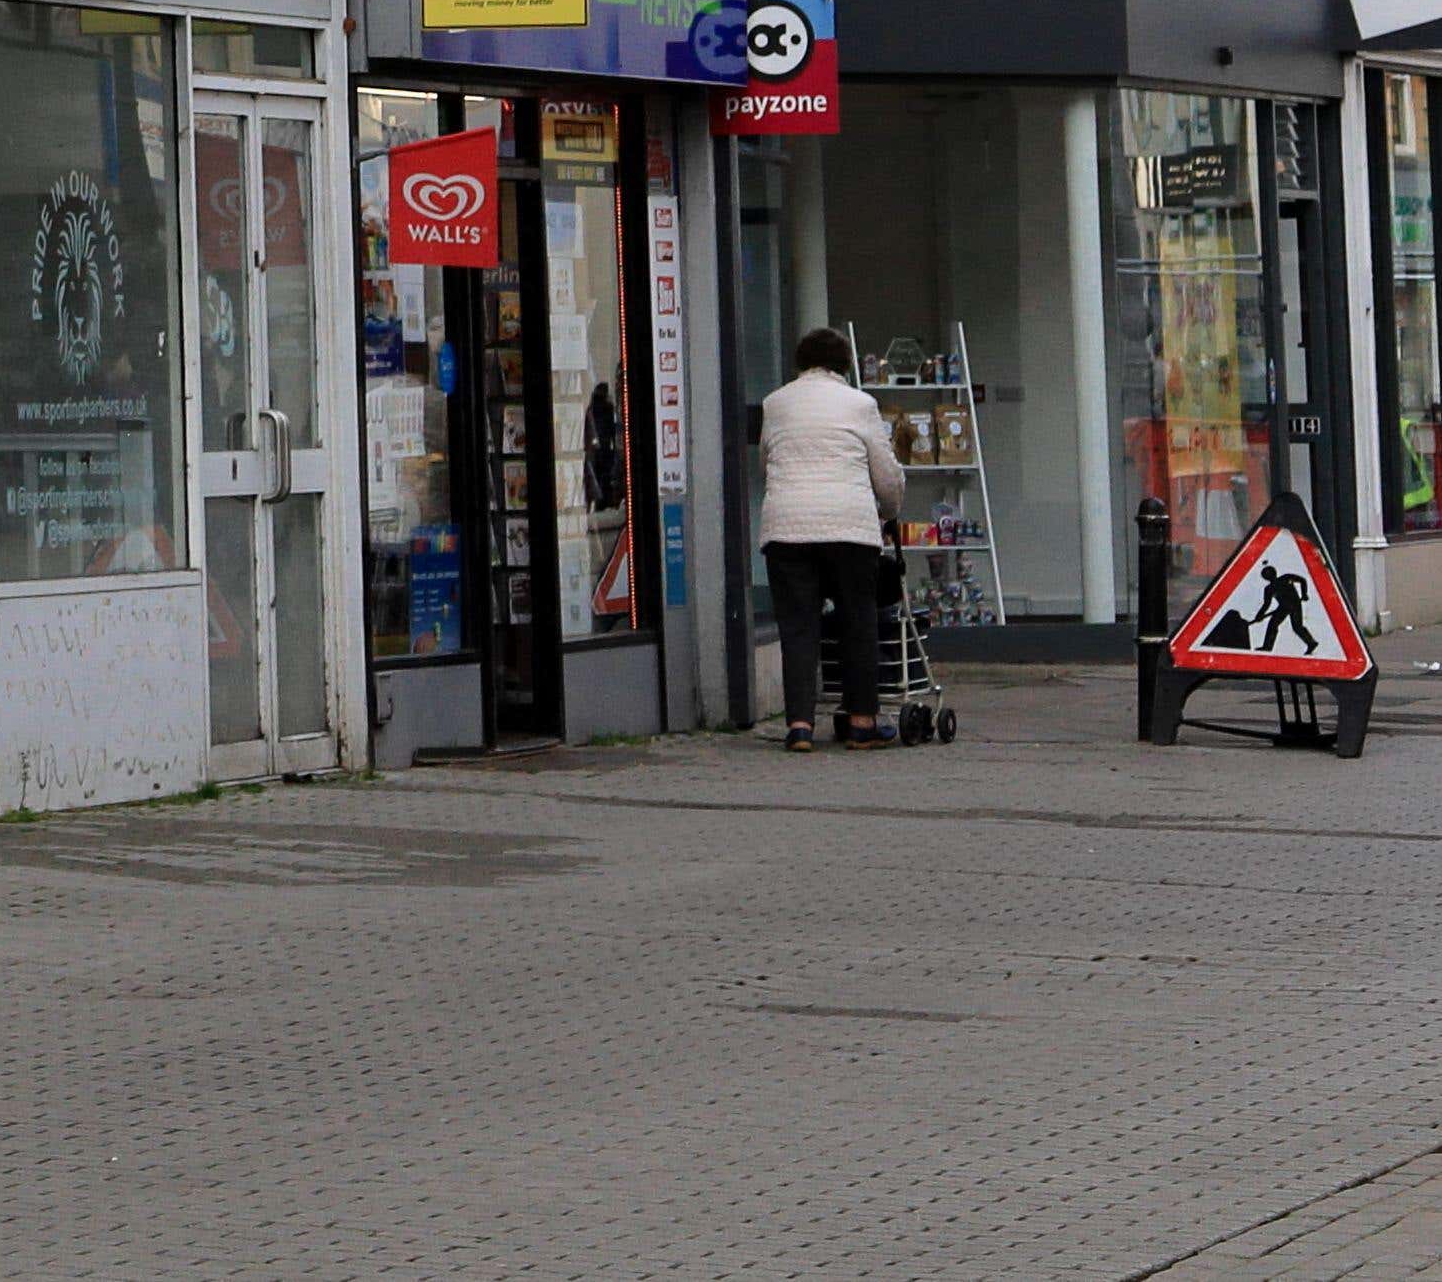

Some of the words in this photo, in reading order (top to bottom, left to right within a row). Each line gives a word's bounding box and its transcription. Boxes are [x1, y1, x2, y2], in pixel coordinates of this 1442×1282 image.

[725, 91, 828, 122] payzone
[32, 204, 53, 321] PRIDE
[50, 175, 66, 212] IN
[69, 169, 100, 214] OUR
[100, 199, 125, 318] WORK
[408, 223, 481, 245] WALL'S
[16, 395, 148, 426] www.sportingbarbers.co.uk
